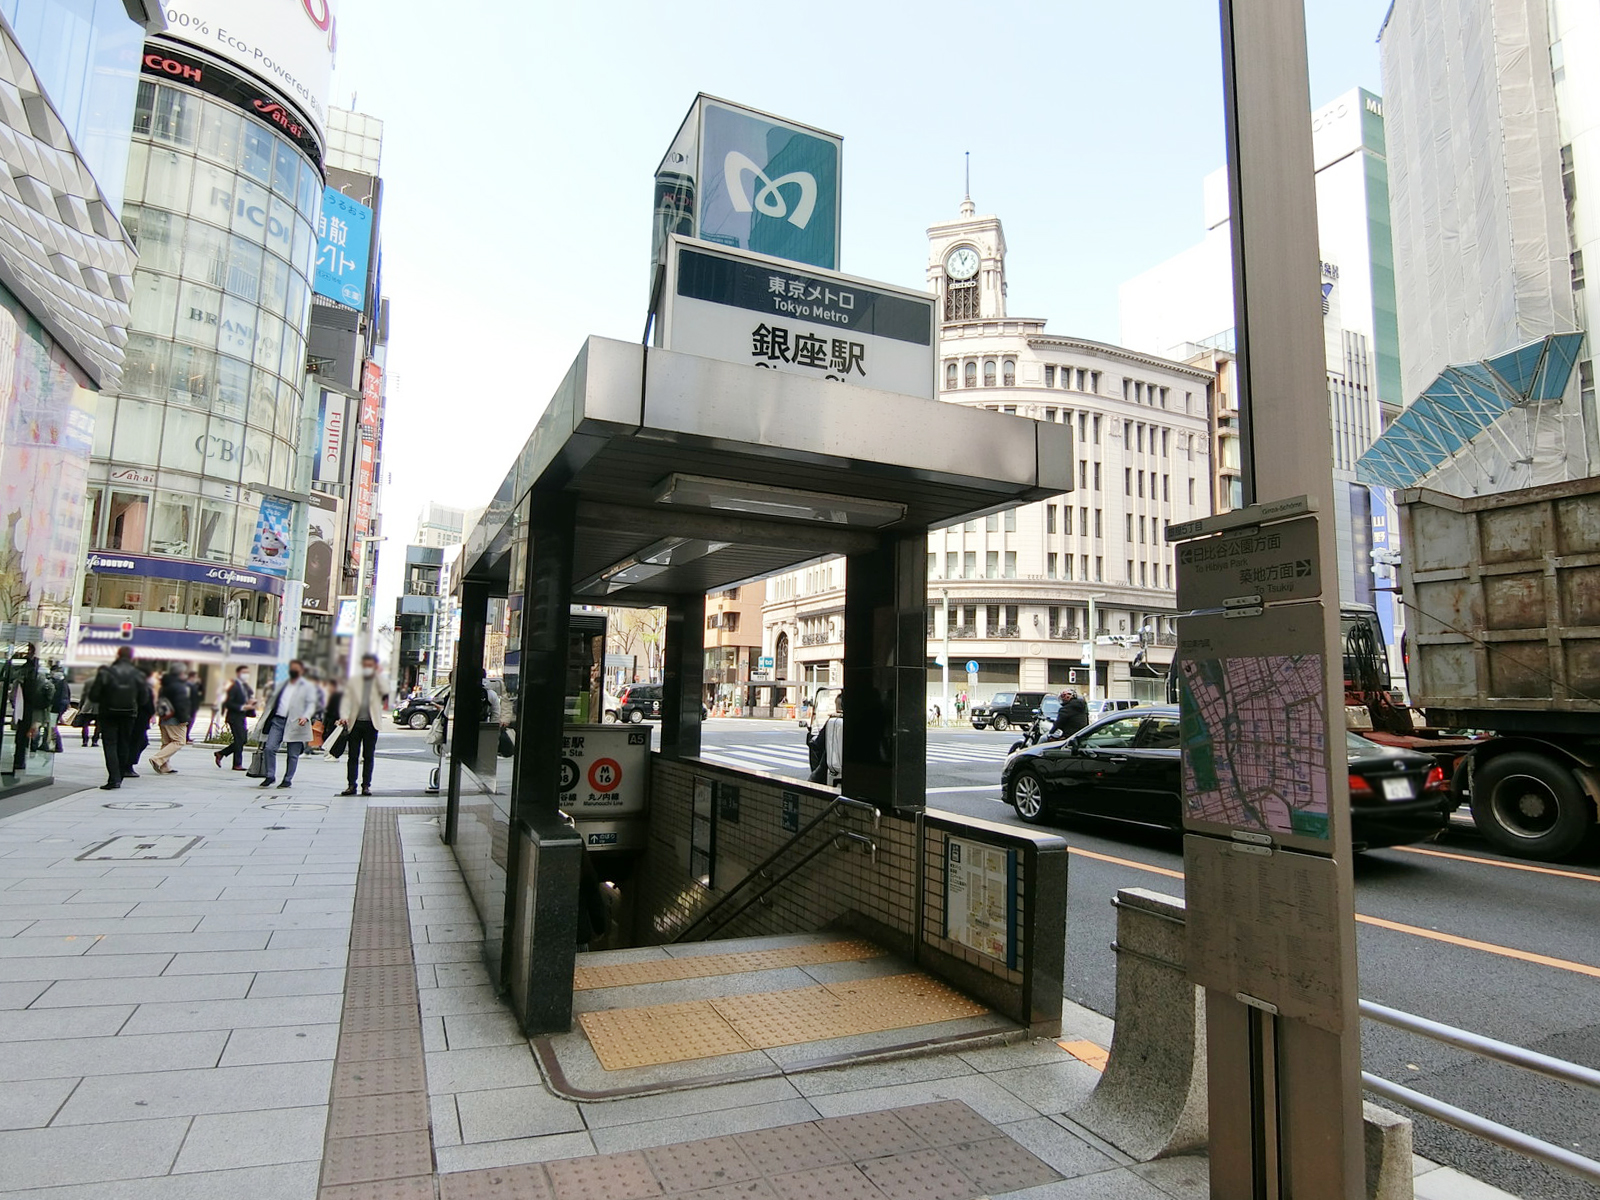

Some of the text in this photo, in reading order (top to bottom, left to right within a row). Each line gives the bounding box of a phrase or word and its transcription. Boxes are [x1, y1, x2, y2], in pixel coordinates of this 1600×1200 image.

[143, 54, 203, 82] COH
[217, 28, 309, 100] Eco-Powered
[323, 194, 366, 220] うるおう
[768, 276, 855, 309] 東京メトロ
[773, 297, 849, 324] Tokyo Metro
[752, 322, 867, 377] 銀座駅
[326, 411, 342, 463] FUJITEC
[112, 470, 155, 483] San-ai
[1193, 533, 1281, 563] 日比谷公園方面
[1195, 564, 1204, 574] To
[1230, 558, 1249, 569] Park
[1239, 562, 1294, 585] 築地方面
[1254, 582, 1294, 594] To Tsukiji
[629, 735, 645, 745] A5
[569, 749, 585, 757] Sta.
[600, 774, 612, 783] 16
[601, 766, 610, 774] M
[588, 792, 619, 801] 丸ノ内線
